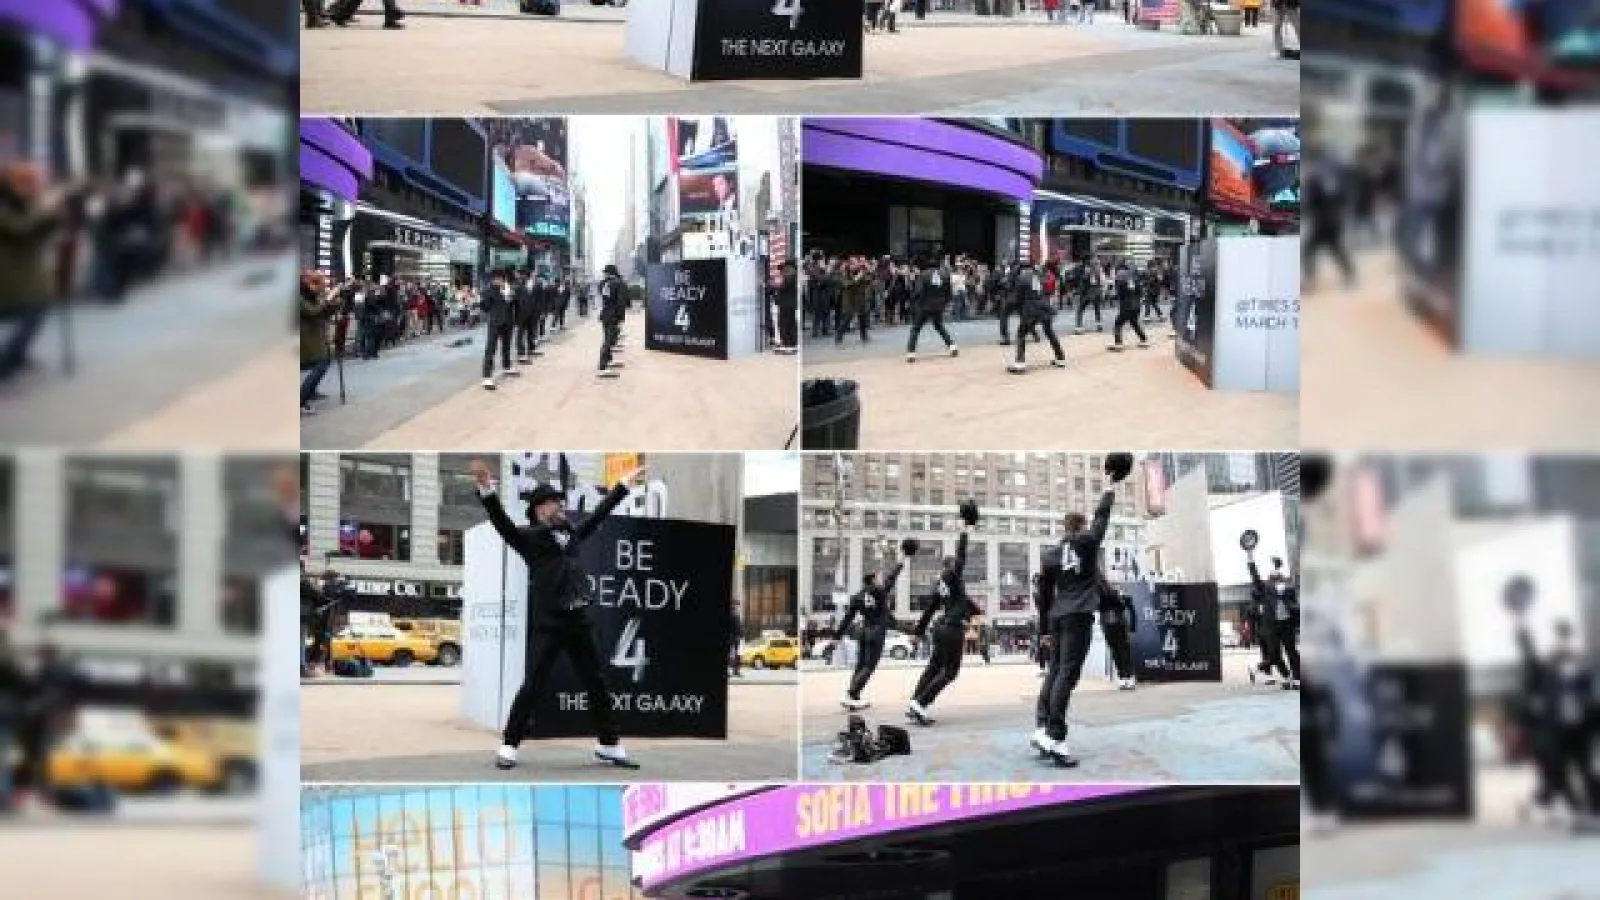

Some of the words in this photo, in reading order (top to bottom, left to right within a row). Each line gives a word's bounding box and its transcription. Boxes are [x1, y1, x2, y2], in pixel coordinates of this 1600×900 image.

[720, 39, 748, 56] THE
[750, 39, 788, 56] NEXT
[616, 539, 655, 572] BE
[609, 617, 649, 683] 4
[1161, 628, 1179, 659] 4
[556, 691, 590, 712] THE
[795, 784, 873, 839] SOFIA
